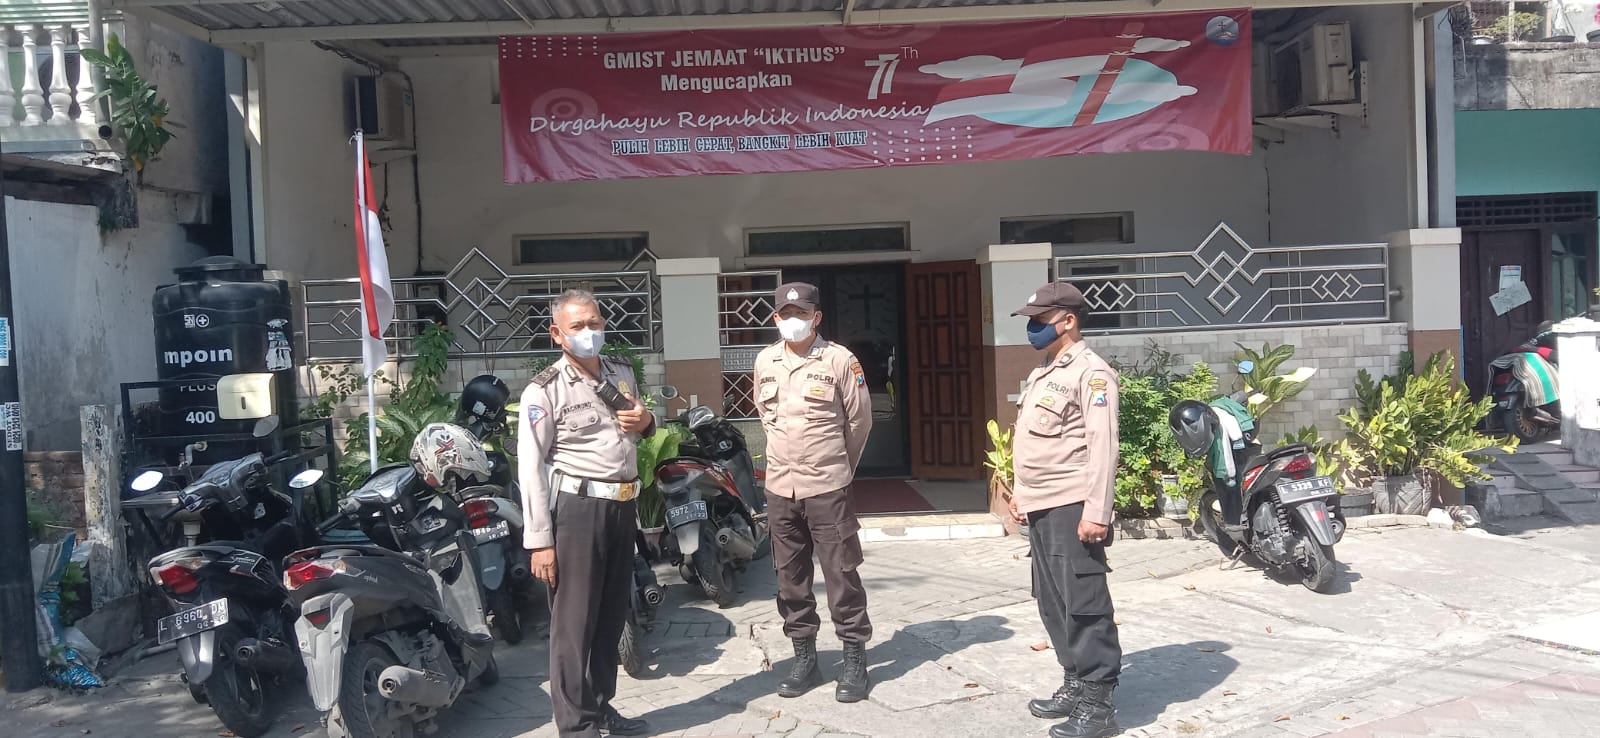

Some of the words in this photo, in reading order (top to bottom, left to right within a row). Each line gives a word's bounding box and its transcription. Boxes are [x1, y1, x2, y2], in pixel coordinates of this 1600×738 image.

[603, 51, 665, 69] GMIST
[671, 48, 747, 67] JEMAAT
[901, 46, 919, 59] Th
[660, 71, 792, 93] Mengucapkan
[865, 54, 900, 99] 77
[530, 112, 670, 136] Dirgahayu
[678, 107, 799, 131] Republik
[805, 101, 930, 123] Indonesia
[612, 139, 649, 155] PULIH
[654, 137, 690, 153] LEBIH
[695, 136, 734, 153] CEPAT,
[738, 134, 790, 150] BANGKIT
[795, 133, 831, 148] LEBIH
[835, 130, 867, 146] KUAT
[164, 348, 233, 367] mpoin
[806, 373, 835, 385] POLRI
[1046, 381, 1070, 394] POLRI
[186, 411, 216, 424] 400
[1280, 486, 1288, 494] L
[671, 506, 689, 518] 5972
[695, 503, 705, 511] YE
[160, 620, 168, 632] L
